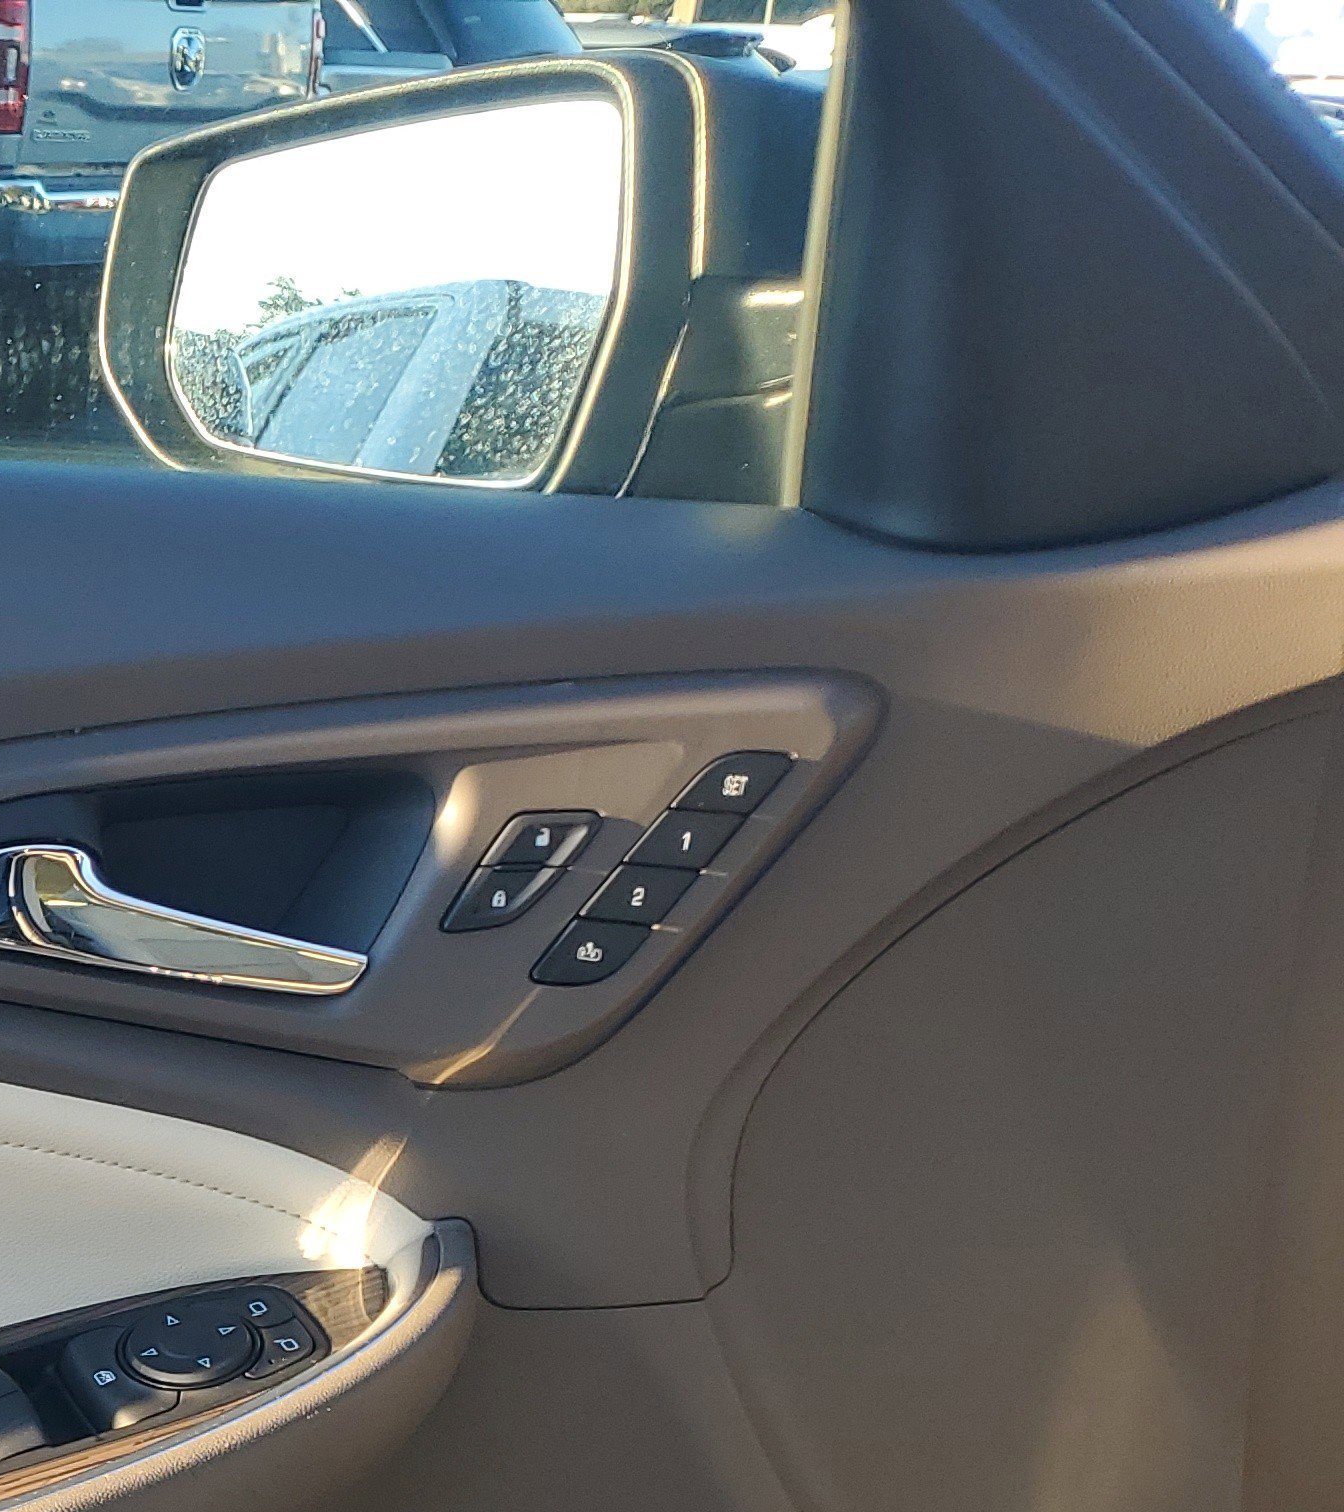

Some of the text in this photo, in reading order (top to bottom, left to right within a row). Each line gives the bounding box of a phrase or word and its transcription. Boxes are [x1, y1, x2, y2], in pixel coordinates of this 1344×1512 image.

[722, 774, 749, 796] SET
[681, 831, 692, 851] 1
[631, 887, 645, 906] 2
